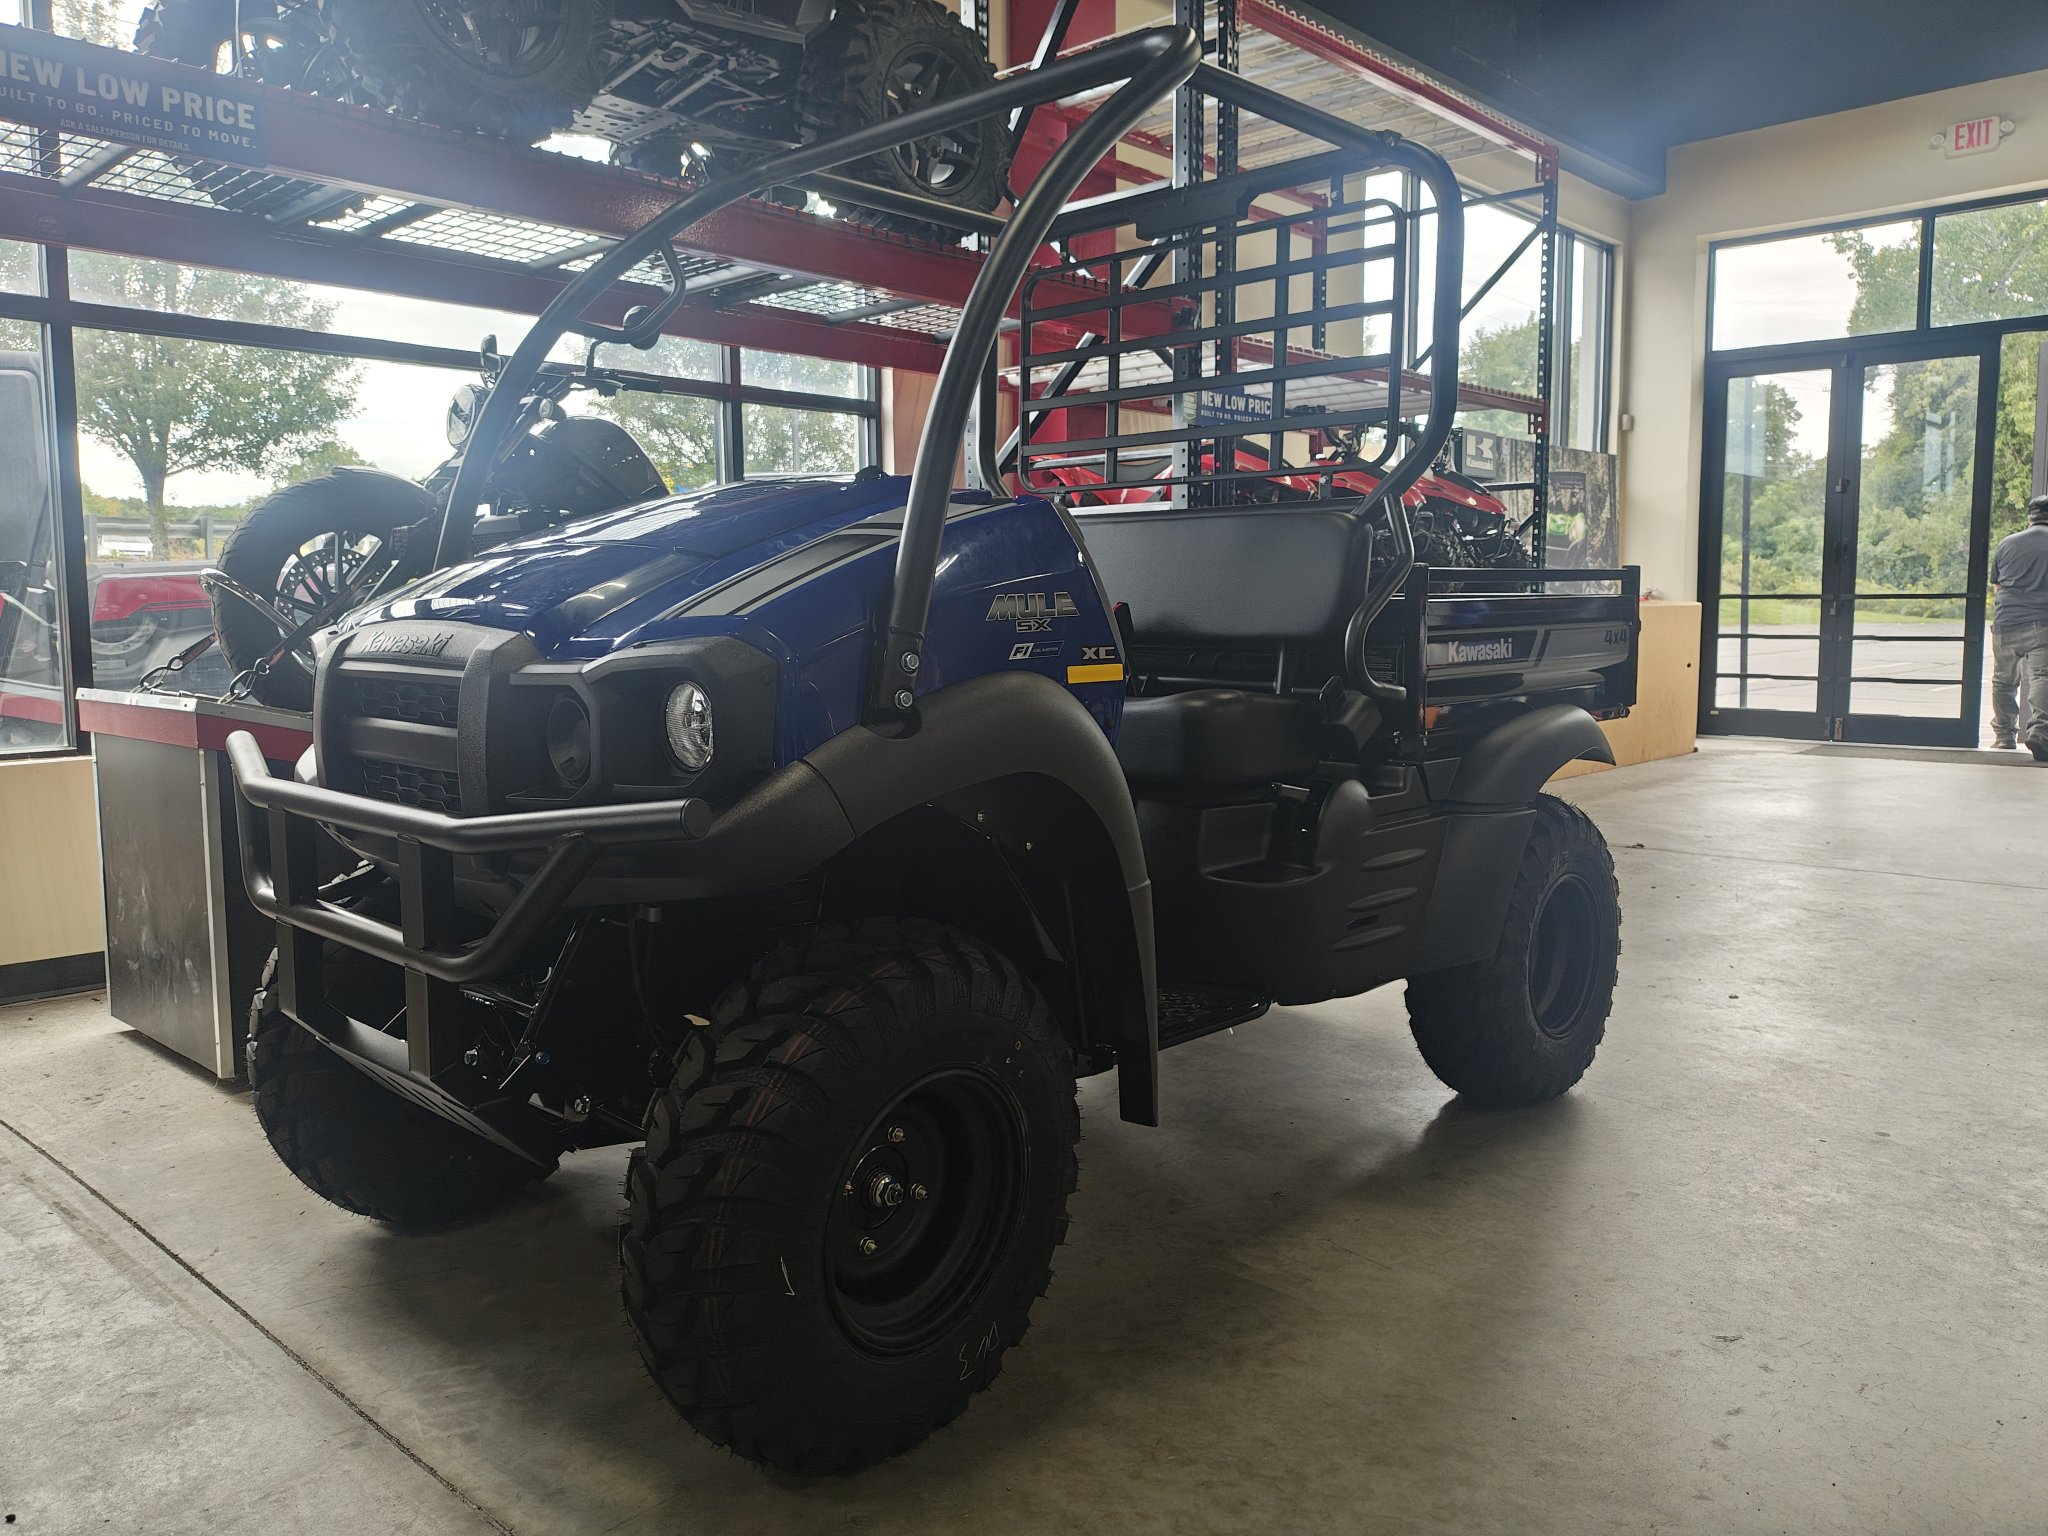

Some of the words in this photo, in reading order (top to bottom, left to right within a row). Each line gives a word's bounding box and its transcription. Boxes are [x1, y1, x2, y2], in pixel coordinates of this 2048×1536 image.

[76, 66, 149, 107] LOW
[162, 86, 256, 130] PRICE
[0, 86, 36, 103] UILT
[45, 95, 67, 110] TO
[75, 102, 103, 118] GO.
[112, 110, 174, 132] PRICED
[181, 124, 201, 138] TO
[208, 130, 257, 149] MOVE.
[60, 118, 76, 129] ASK
[78, 121, 84, 131] A
[85, 123, 141, 142] SALESPERSON
[142, 134, 158, 144] FOR
[1954, 118, 1993, 150] EXIT
[1201, 390, 1222, 408] NEW
[1225, 394, 1246, 412] LOW
[1248, 398, 1271, 415] PRIC
[985, 591, 1080, 621] MULE
[1016, 619, 1052, 633] SX
[1604, 628, 1628, 646] 4x4
[361, 628, 454, 656] Kawasaki
[1011, 644, 1032, 658] FI
[1082, 646, 1116, 660] XC
[1447, 637, 1513, 664] Kawasaki
